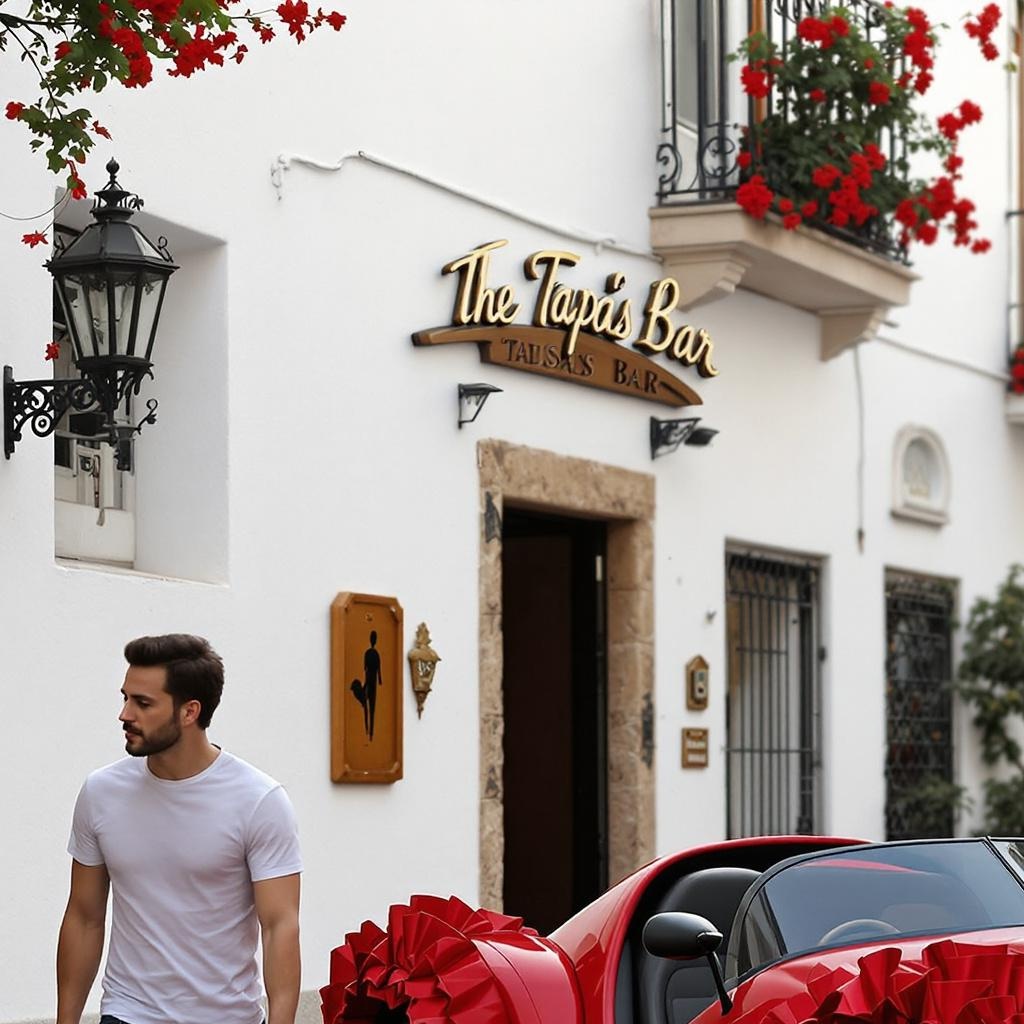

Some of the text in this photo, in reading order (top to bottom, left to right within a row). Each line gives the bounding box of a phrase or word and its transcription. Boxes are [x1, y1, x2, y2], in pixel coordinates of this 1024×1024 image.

[443, 239, 522, 326] The
[634, 277, 720, 378] Bar
[613, 358, 660, 394] BAR
